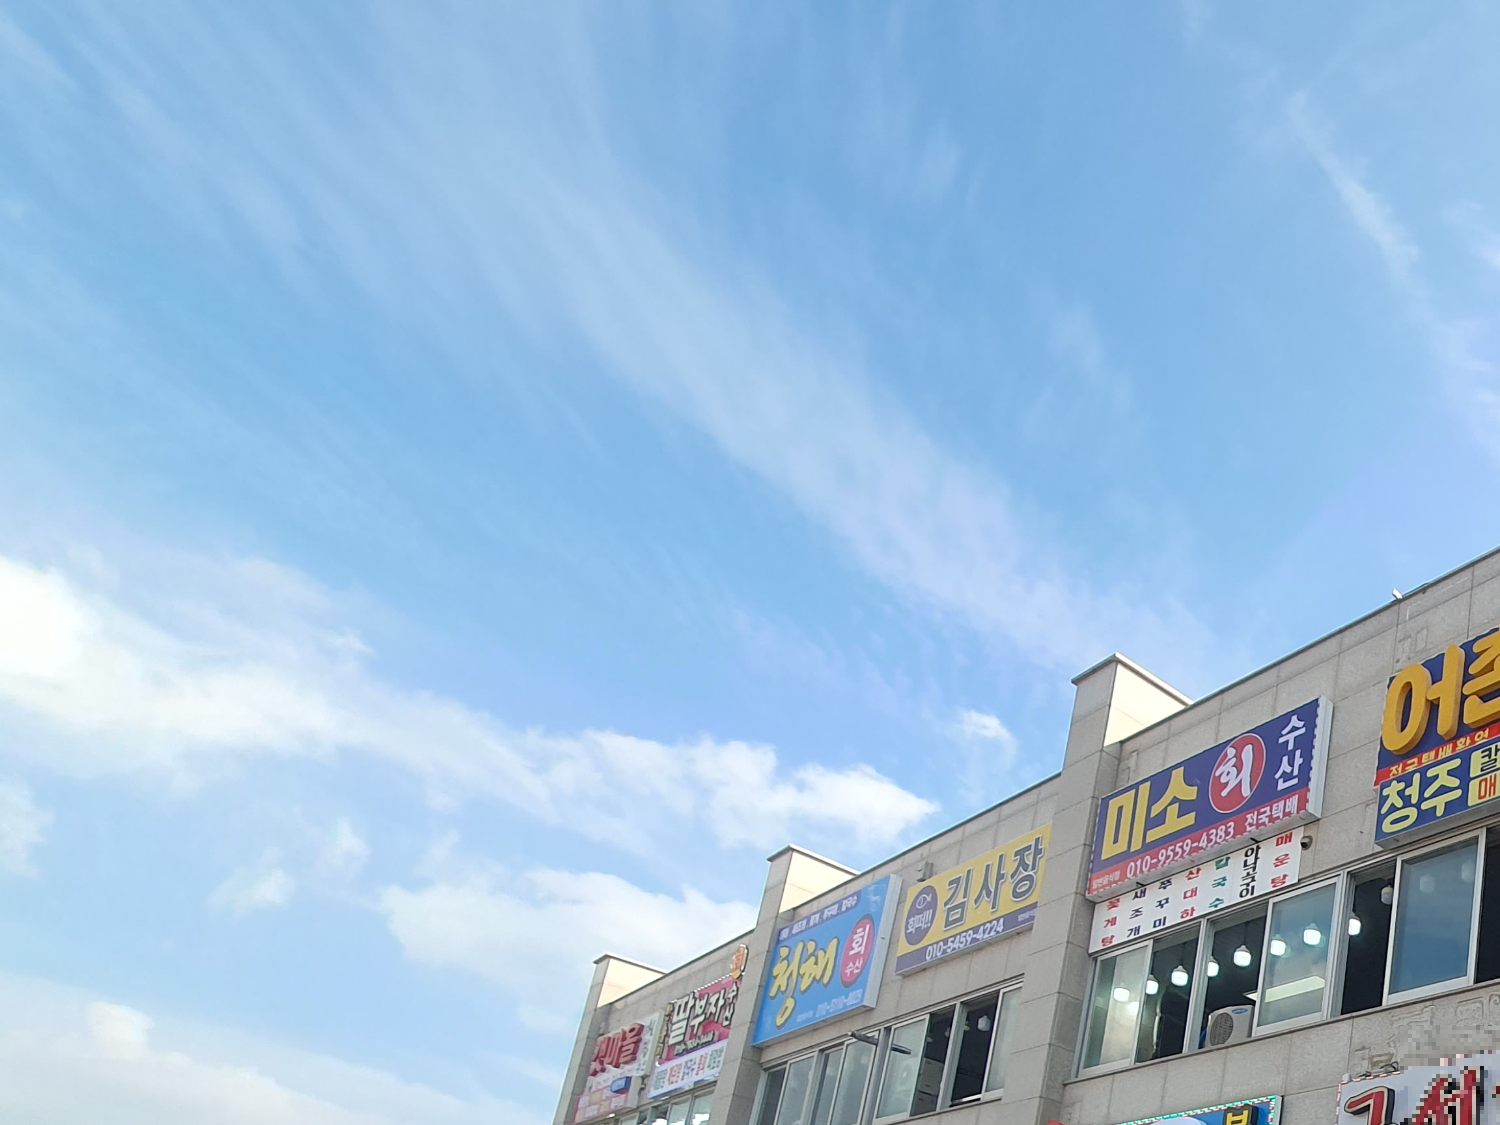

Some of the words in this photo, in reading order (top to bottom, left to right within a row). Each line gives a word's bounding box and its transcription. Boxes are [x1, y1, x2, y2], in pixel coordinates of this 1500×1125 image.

[1215, 745, 1253, 797] 회
[1275, 715, 1305, 791] 수산
[1102, 767, 1198, 860] 미소
[1381, 770, 1462, 833] 청주
[1127, 822, 1234, 876] 010-9559-4383
[1245, 795, 1299, 831] 전국택배
[1271, 832, 1293, 888] 매운탕
[943, 835, 1044, 931] 김사장
[1180, 868, 1201, 919] 산대하
[925, 918, 1004, 961] 010-5459-4224
[1127, 888, 1148, 937] 새조개
[845, 959, 862, 977] 수산
[850, 925, 869, 957] 회
